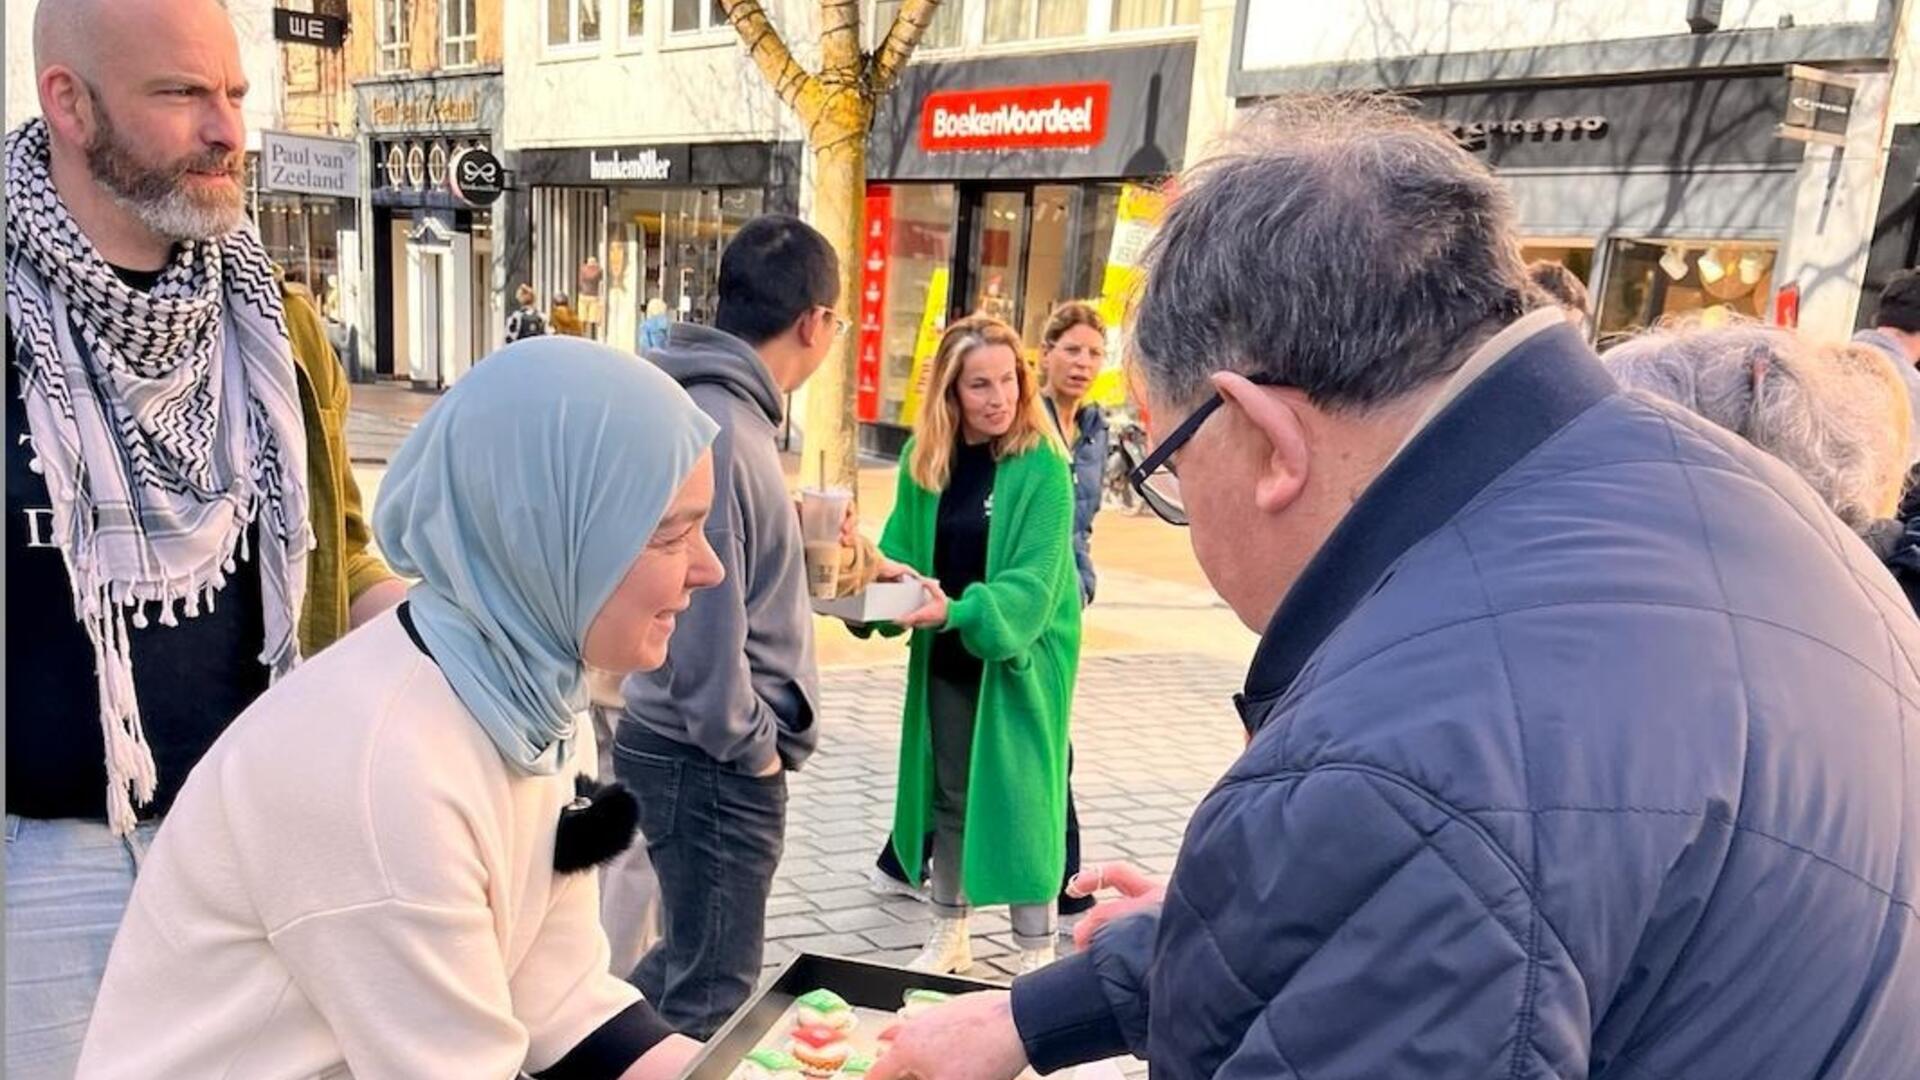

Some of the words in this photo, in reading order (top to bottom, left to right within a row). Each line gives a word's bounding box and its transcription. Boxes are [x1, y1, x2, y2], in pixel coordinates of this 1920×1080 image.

[289, 16, 324, 39] WE
[932, 97, 1093, 138] BoekenVoordeel
[272, 143, 310, 165] Paul
[313, 151, 343, 169] van
[272, 165, 344, 189] Zeeland
